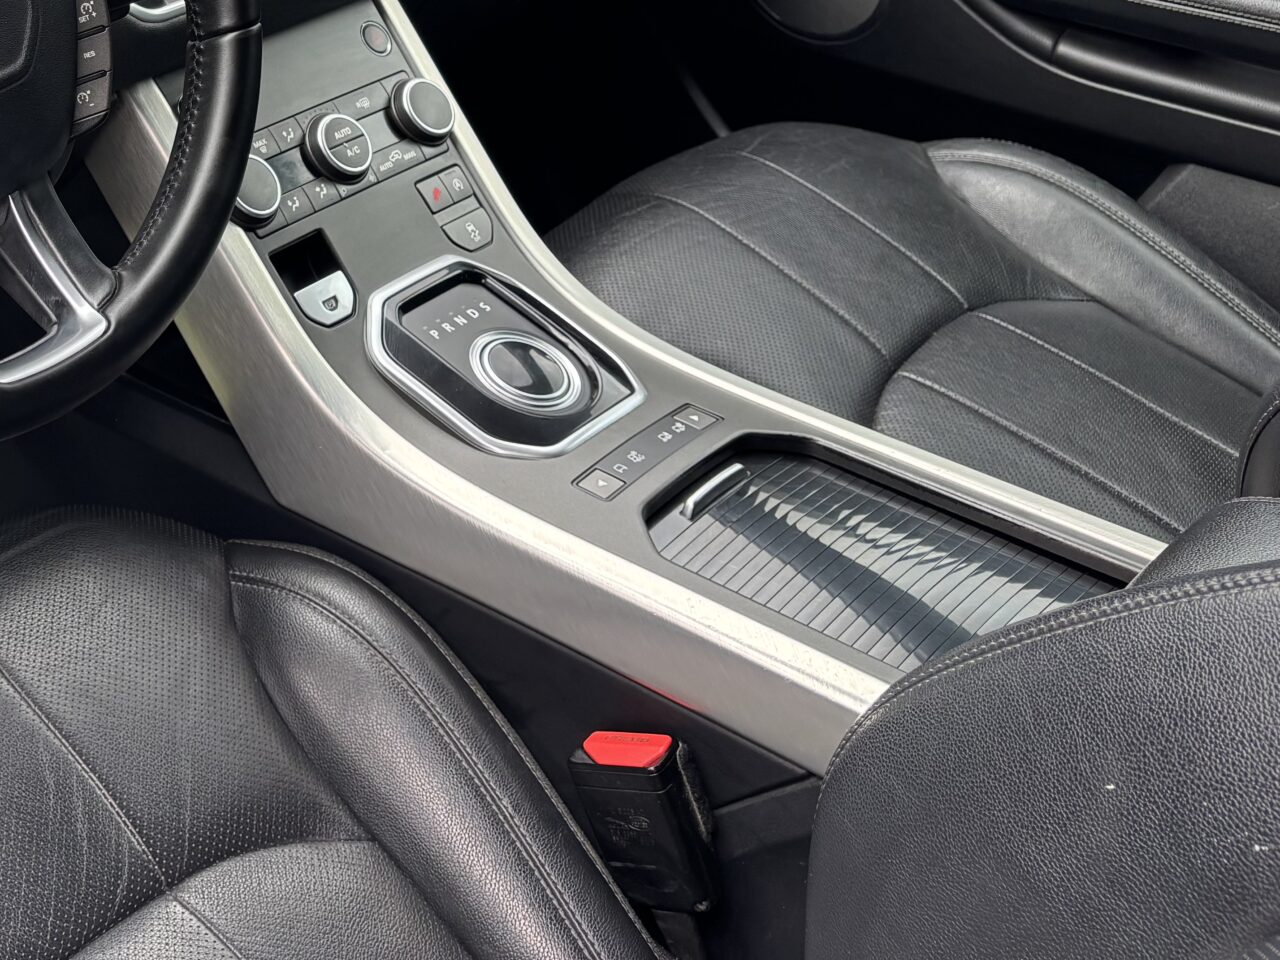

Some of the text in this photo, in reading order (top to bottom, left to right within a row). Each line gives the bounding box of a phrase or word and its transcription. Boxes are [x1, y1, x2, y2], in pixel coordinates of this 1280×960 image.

[78, 14, 90, 24] SET
[83, 50, 96, 59] RES
[334, 126, 352, 141] AUTO
[252, 138, 268, 149] MAX
[346, 145, 360, 157] A/C
[429, 301, 491, 340] P R N D S
